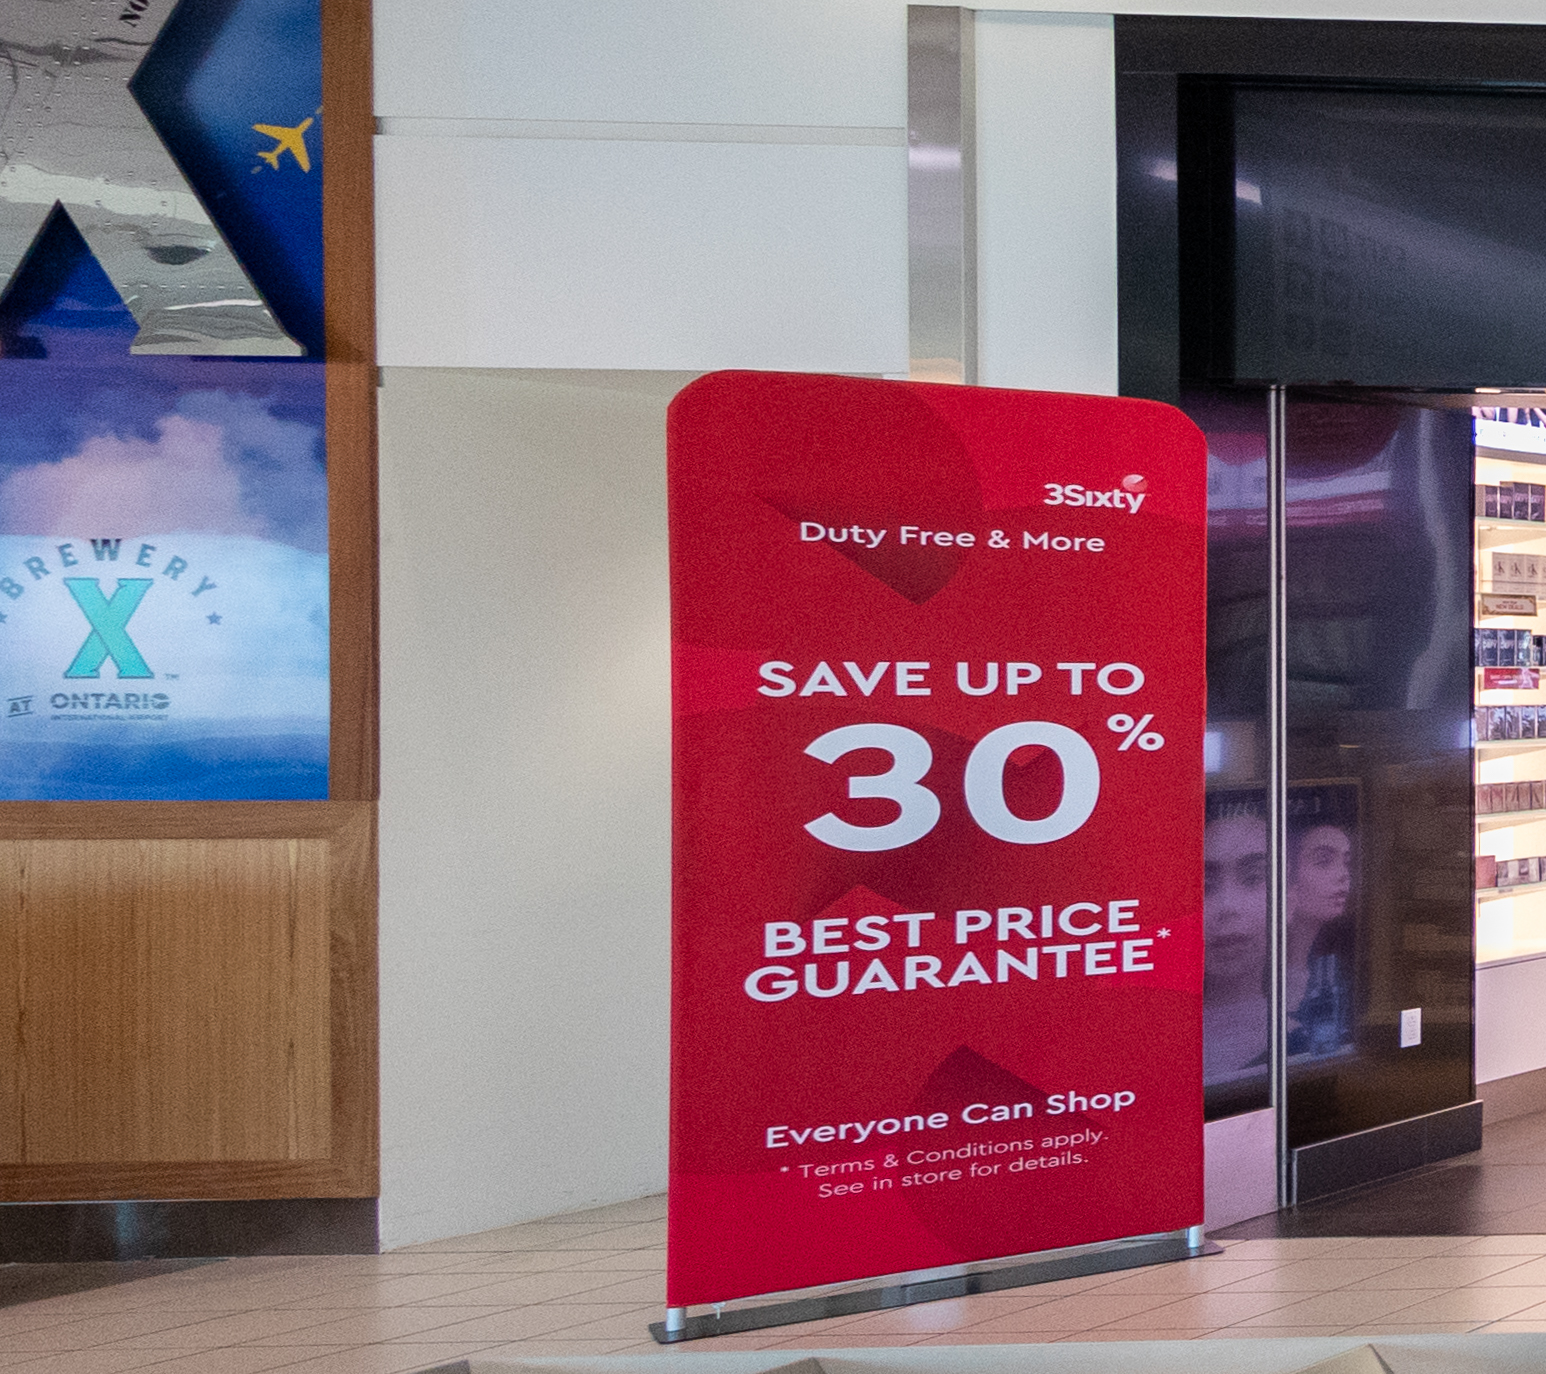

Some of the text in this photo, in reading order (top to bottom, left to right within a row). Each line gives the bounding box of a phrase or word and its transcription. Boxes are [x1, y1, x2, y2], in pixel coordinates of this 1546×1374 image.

[1043, 482, 1146, 514] 3Sixty
[799, 521, 1106, 552] Duty Free & More
[0, 538, 218, 601] BREWERY
[62, 577, 155, 680] X
[9, 692, 171, 714] AT ONTARIO
[756, 660, 1146, 698] SAVE UP TO
[50, 713, 126, 721] INTERNATIONAL
[802, 712, 1166, 853] 30%
[763, 899, 1140, 959] BEST PRICE
[765, 1089, 1137, 1150] Everyone Can Shop
[798, 1128, 1110, 1179] Terms & Conditions apply.
[818, 1150, 1090, 1199] See in store for details.
